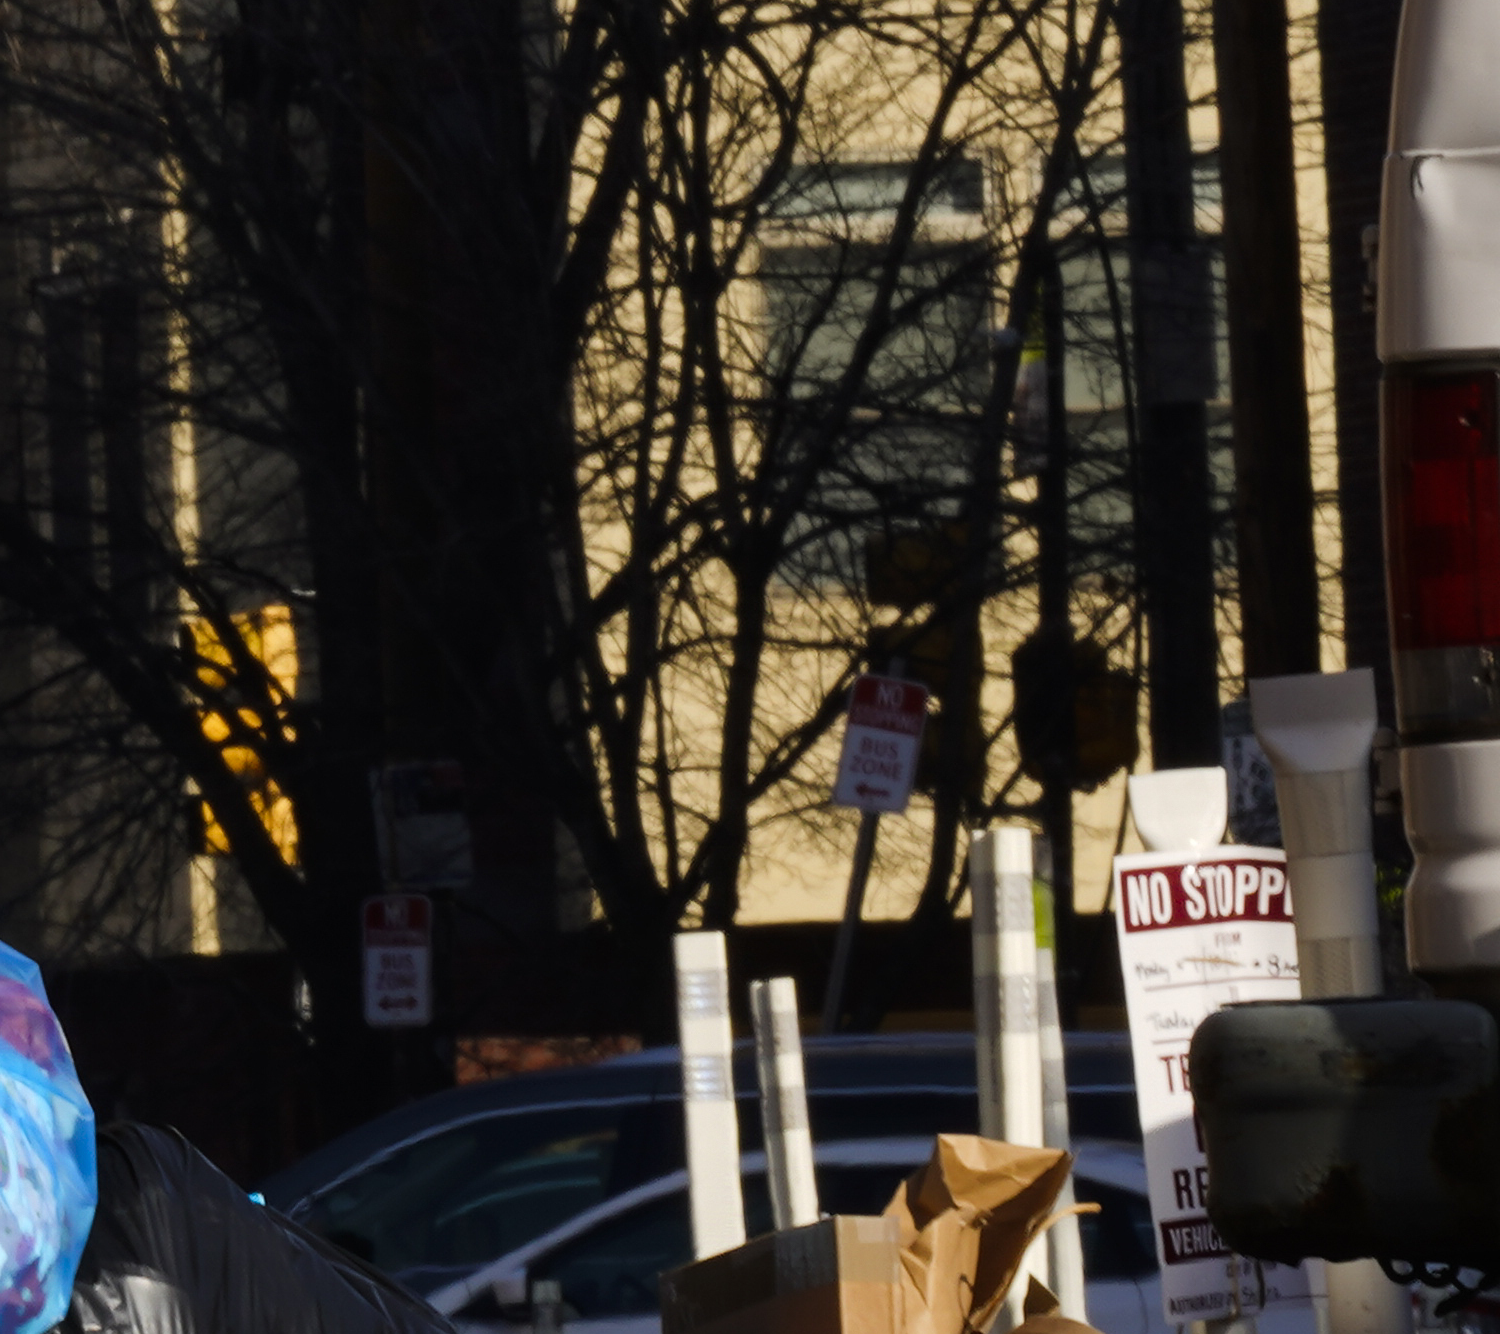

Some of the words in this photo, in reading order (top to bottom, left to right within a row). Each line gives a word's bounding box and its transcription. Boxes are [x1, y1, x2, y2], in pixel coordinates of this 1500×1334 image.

[849, 754, 902, 781] ZONE
[859, 735, 899, 761] BUS
[1125, 870, 1173, 928] NO
[1180, 863, 1295, 921] STOPPI
[1159, 1054, 1192, 1097] TE
[1173, 1166, 1209, 1211] RE
